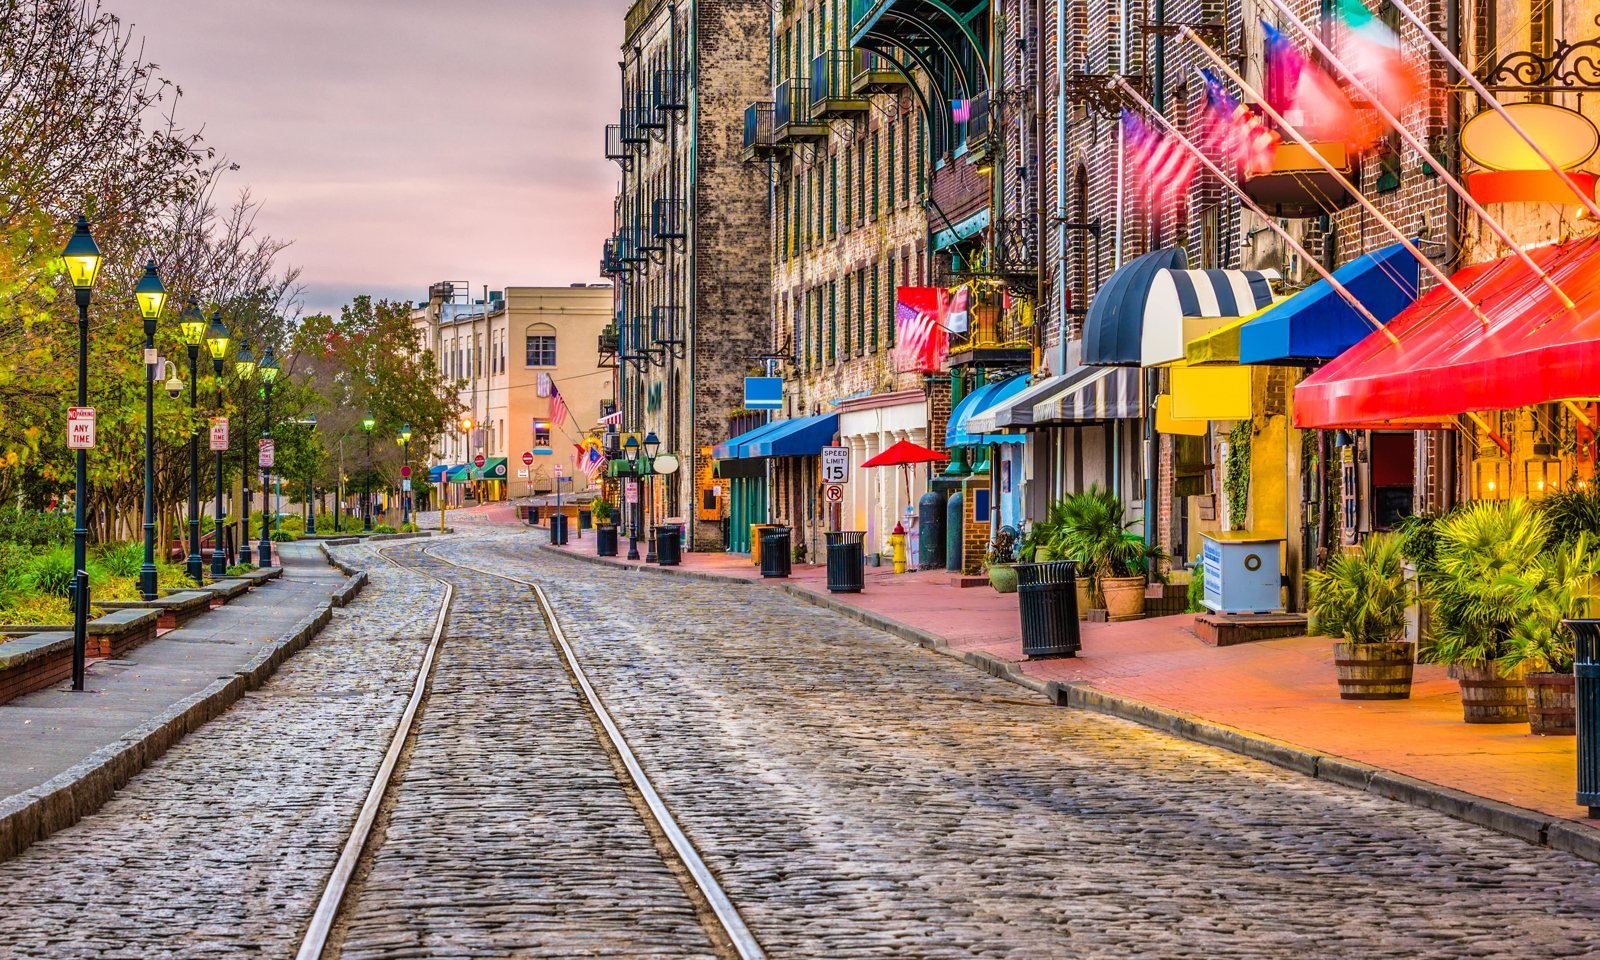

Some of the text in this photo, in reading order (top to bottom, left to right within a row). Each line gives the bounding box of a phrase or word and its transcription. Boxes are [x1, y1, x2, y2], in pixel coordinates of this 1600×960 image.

[69, 410, 77, 419] NO
[74, 424, 89, 432] ANY
[73, 435, 90, 443] TIME
[826, 466, 844, 480] 15
